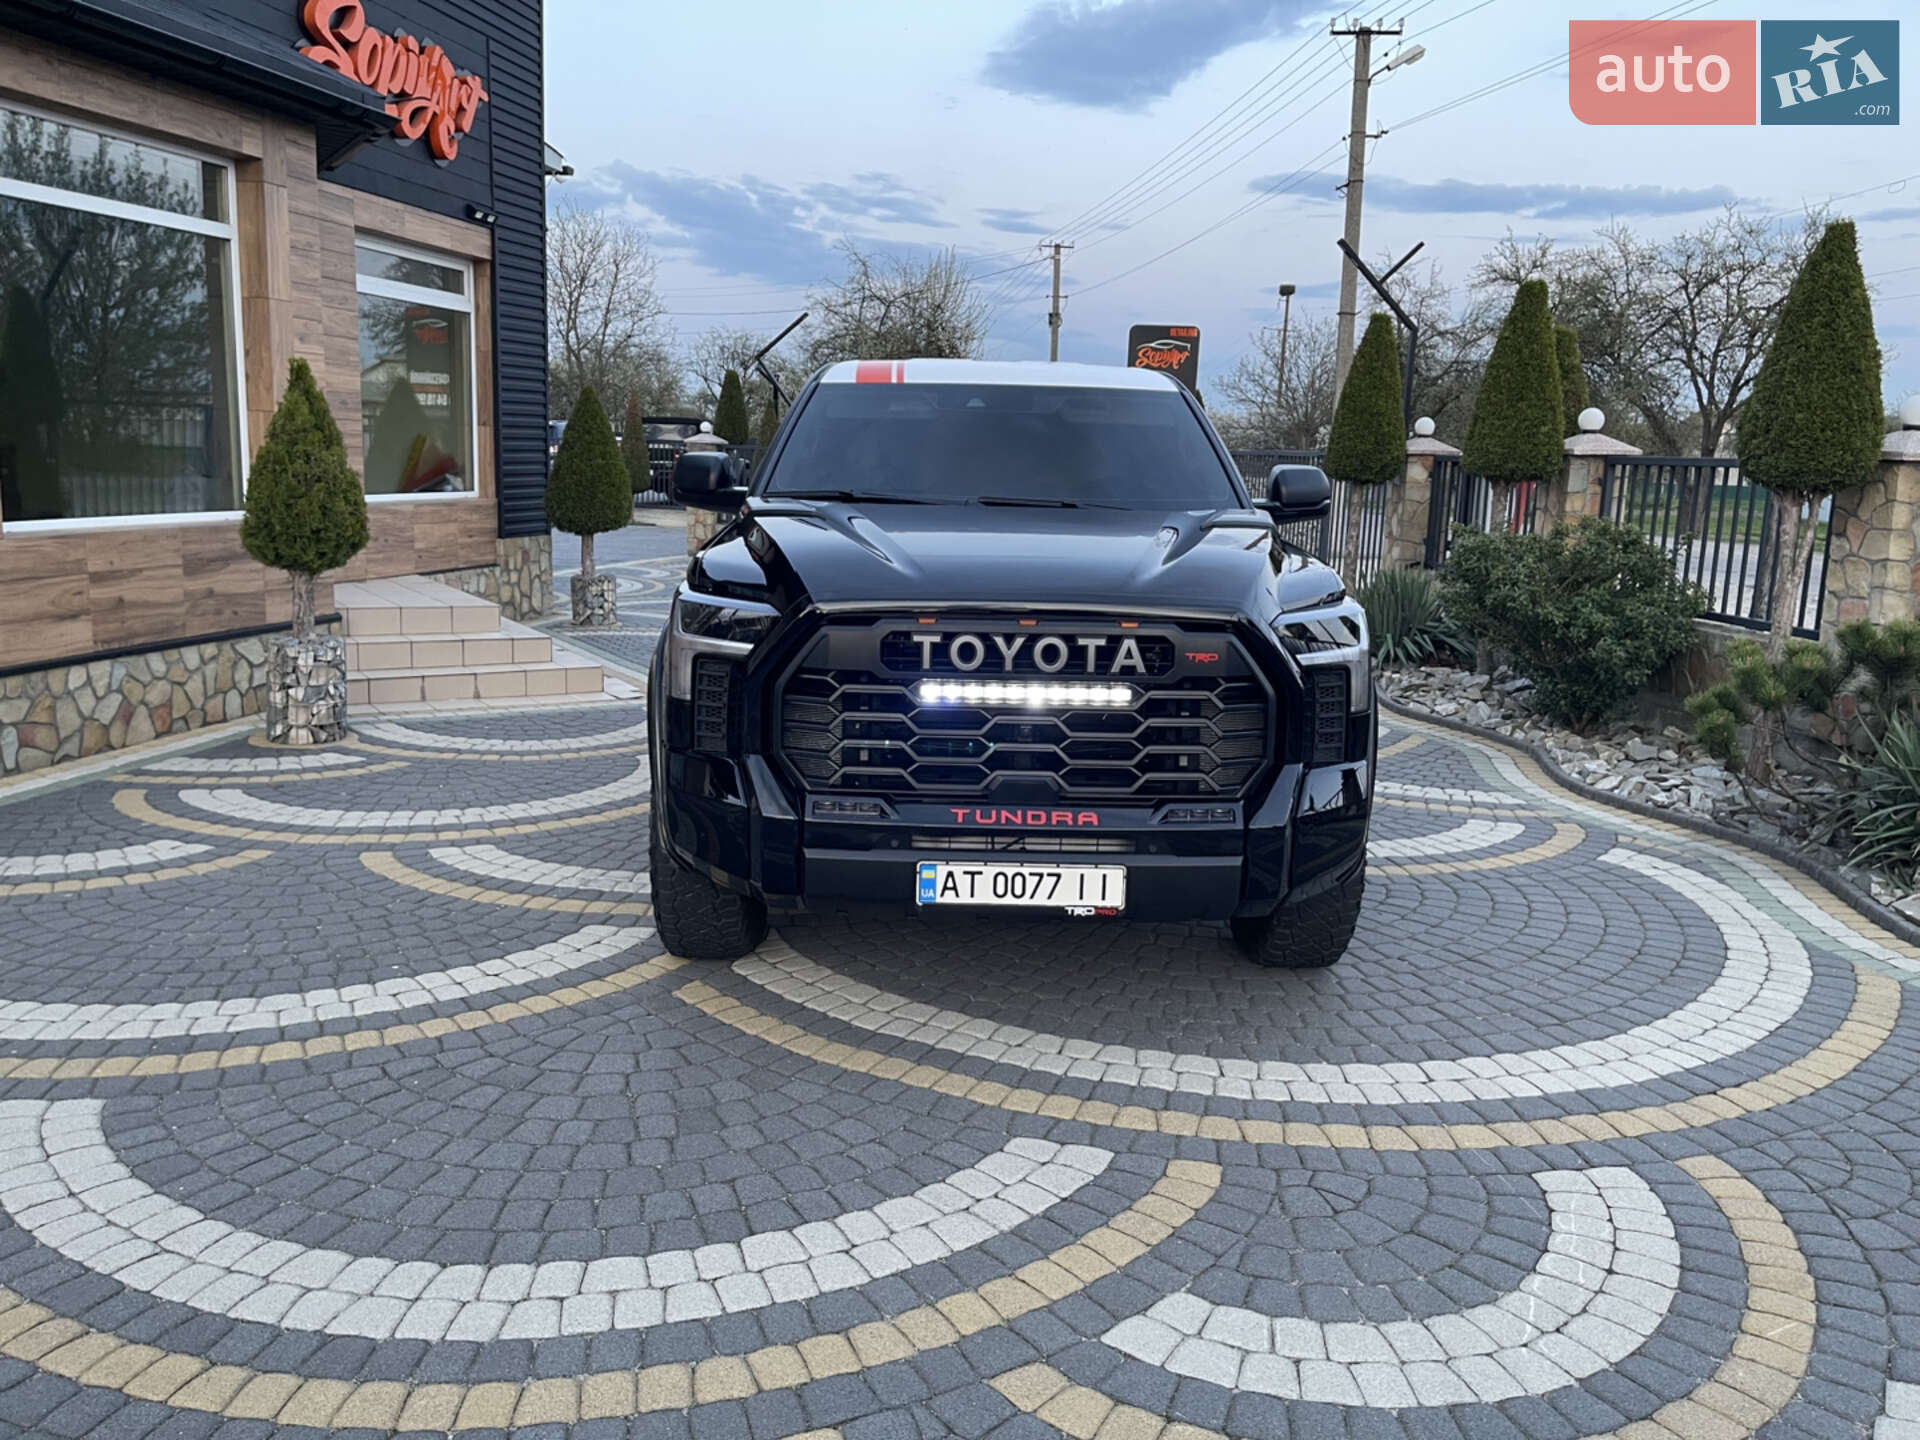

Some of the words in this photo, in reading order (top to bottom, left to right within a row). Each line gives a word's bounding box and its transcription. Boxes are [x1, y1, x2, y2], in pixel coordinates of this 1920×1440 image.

[912, 634, 1147, 673] TOYOTA
[1184, 652, 1219, 664] TRD
[951, 808, 1099, 826] TUNDRA
[940, 870, 983, 898] AT
[992, 871, 1062, 900] 0077
[921, 888, 935, 898] UA
[1064, 906, 1095, 916] TRD
